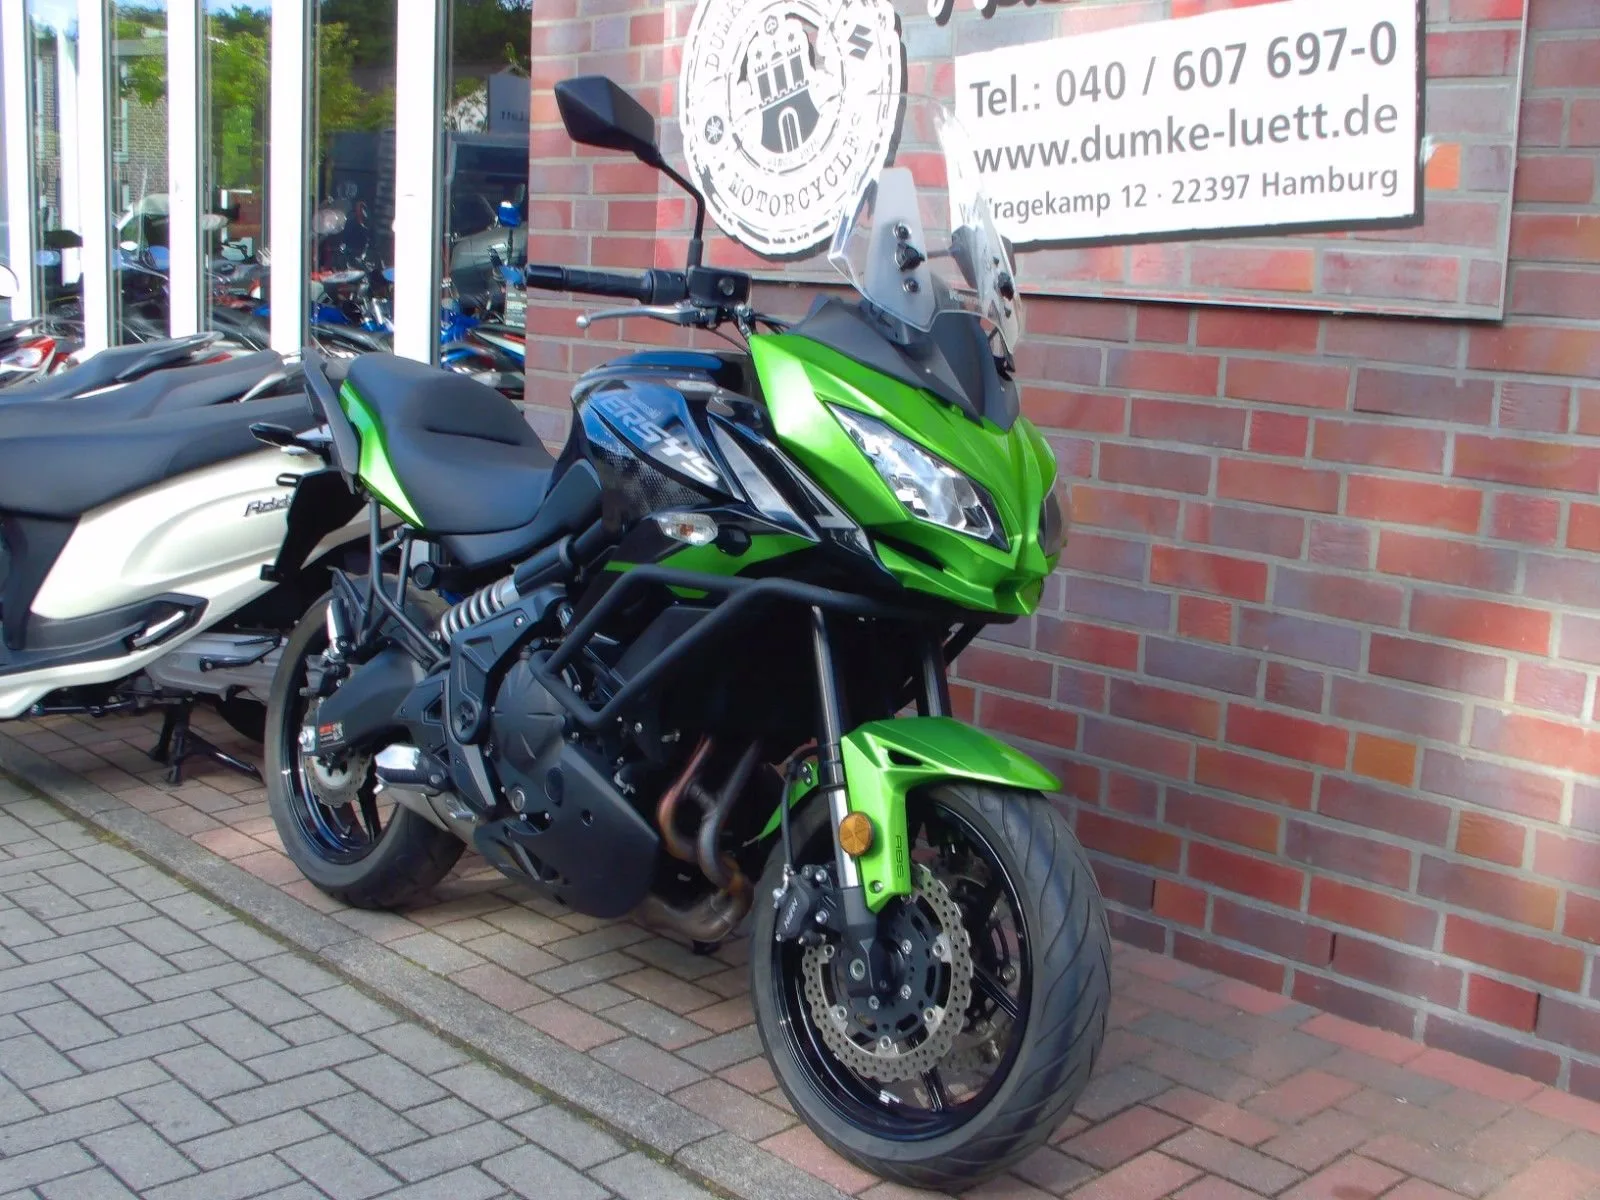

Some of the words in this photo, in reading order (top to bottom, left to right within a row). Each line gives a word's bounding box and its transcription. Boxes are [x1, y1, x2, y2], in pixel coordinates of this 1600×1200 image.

[969, 73, 1041, 117] Tel.:
[1055, 61, 1126, 107] 040
[1142, 56, 1157, 97] /
[1173, 42, 1247, 91] 607
[1266, 20, 1397, 79] 697-0
[973, 93, 1398, 173] www.dumke-luett.de
[1121, 183, 1147, 209] 12
[1171, 173, 1250, 205] 22397
[1262, 165, 1398, 198] Hamburg
[895, 835, 905, 879] ABS
